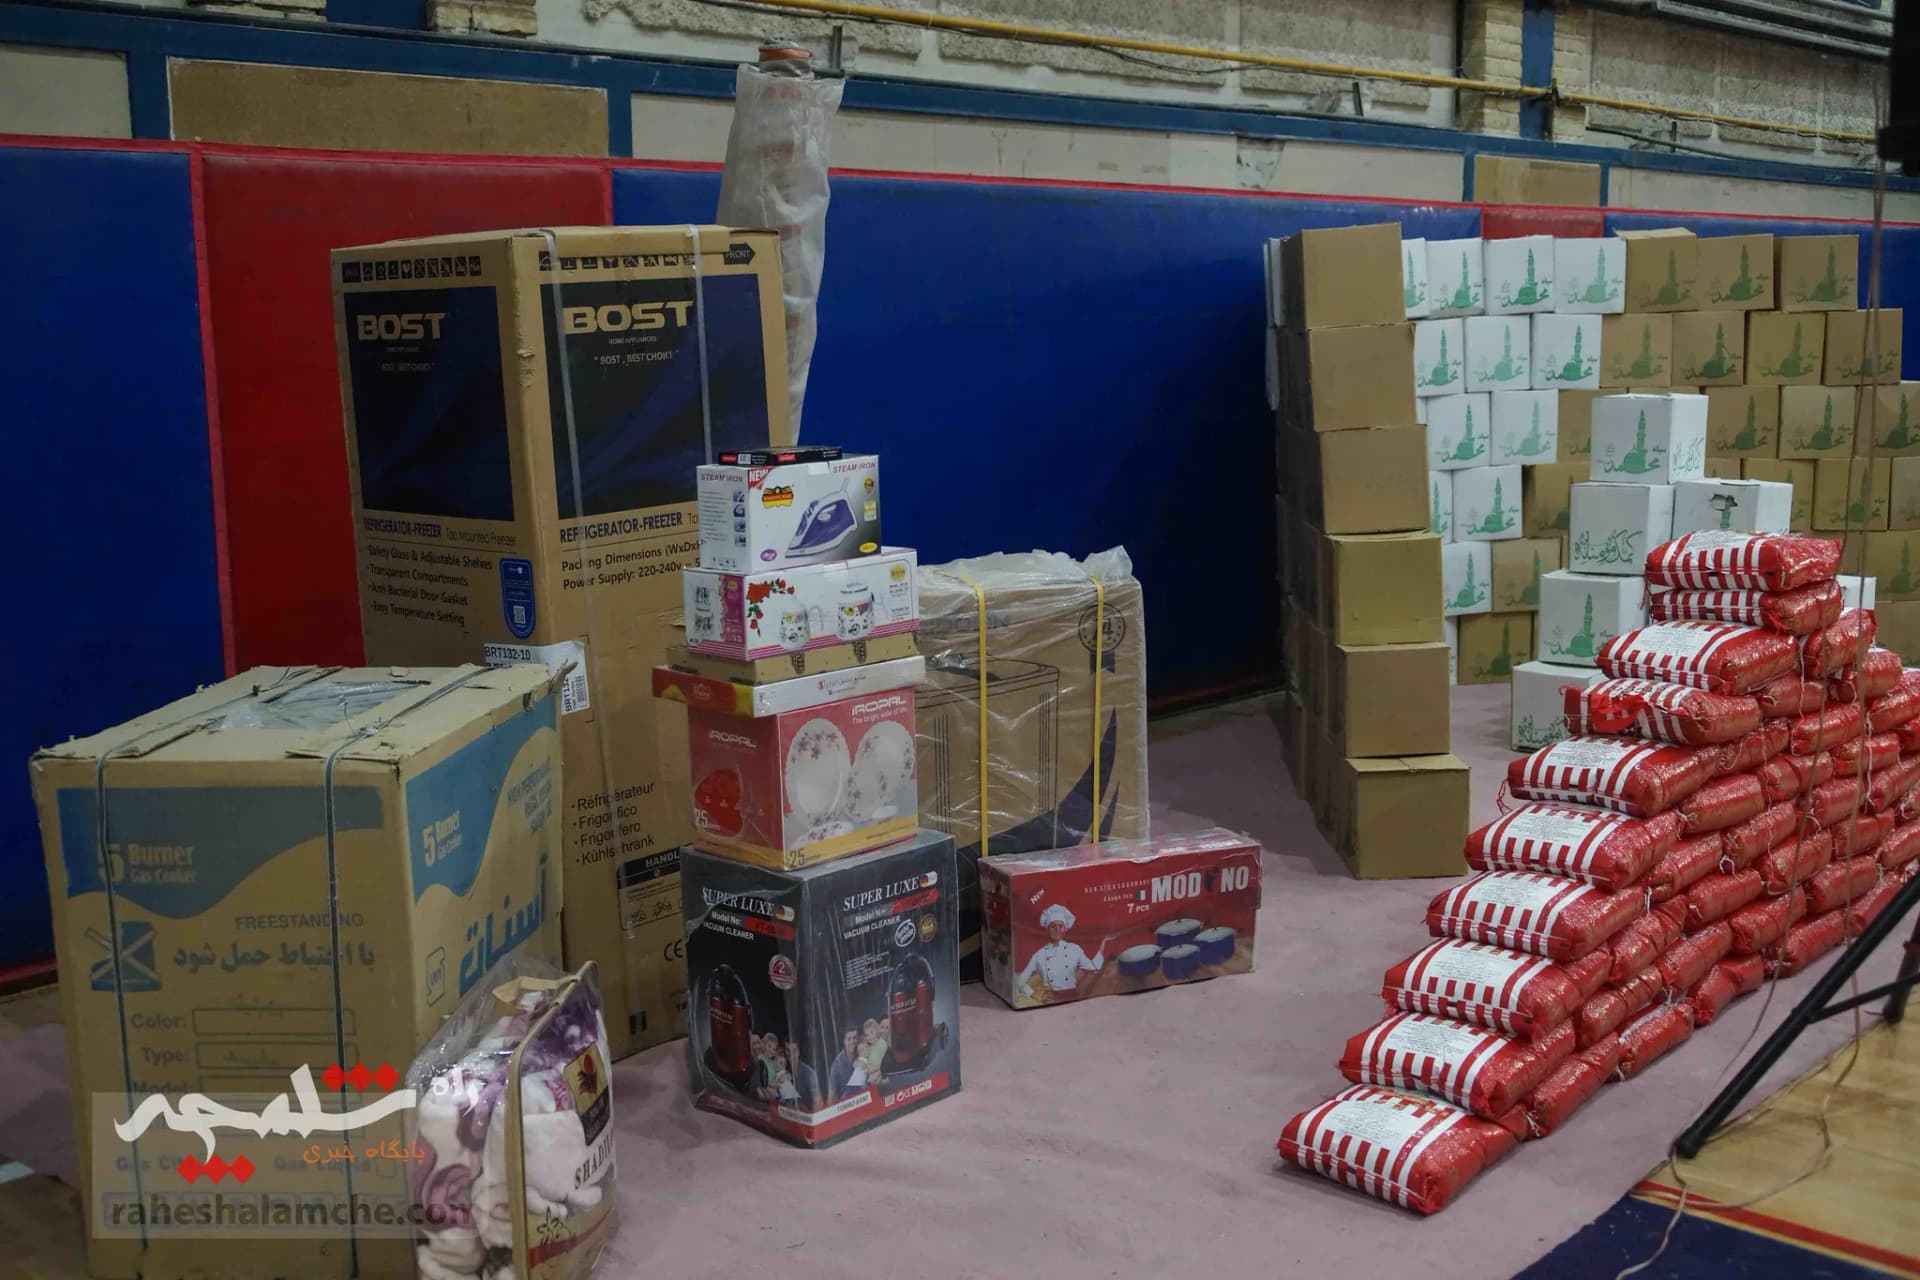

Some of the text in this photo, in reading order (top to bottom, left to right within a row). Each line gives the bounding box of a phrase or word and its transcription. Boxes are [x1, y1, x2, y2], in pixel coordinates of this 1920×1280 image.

[356, 312, 446, 342] BOST
[562, 301, 694, 336] BOST
[700, 472, 744, 484] STEAM IRON
[749, 468, 769, 482] NEW
[832, 461, 876, 474] STEAM IRON
[560, 512, 682, 544] REFIGERATOR-FREEZER
[562, 558, 602, 572] Pacng
[605, 546, 662, 565] Dimensions
[563, 577, 594, 590] Powr
[598, 570, 636, 586] Supply:
[638, 561, 682, 578] 220-240v
[422, 824, 436, 868] 5
[582, 834, 656, 865] Kühlshrank
[790, 848, 805, 869] 25
[97, 844, 194, 883] 5 Burner
[130, 868, 196, 883] Gas Cooker
[702, 887, 776, 918] SUPER LUXE
[843, 876, 920, 912] SUPER LUXE
[236, 912, 364, 930] FREESTANDNG
[711, 910, 730, 924] Model
[855, 909, 874, 924] Model
[1127, 902, 1134, 914] 7
[726, 927, 755, 941] CLEANER
[843, 914, 902, 940] VACUUM CLEANER
[173, 942, 217, 974] شود
[222, 942, 272, 973] حمل
[279, 941, 353, 972] اتیاط
[778, 960, 786, 974] 2
[131, 1012, 186, 1030] Color:
[140, 1047, 192, 1068] Type:
